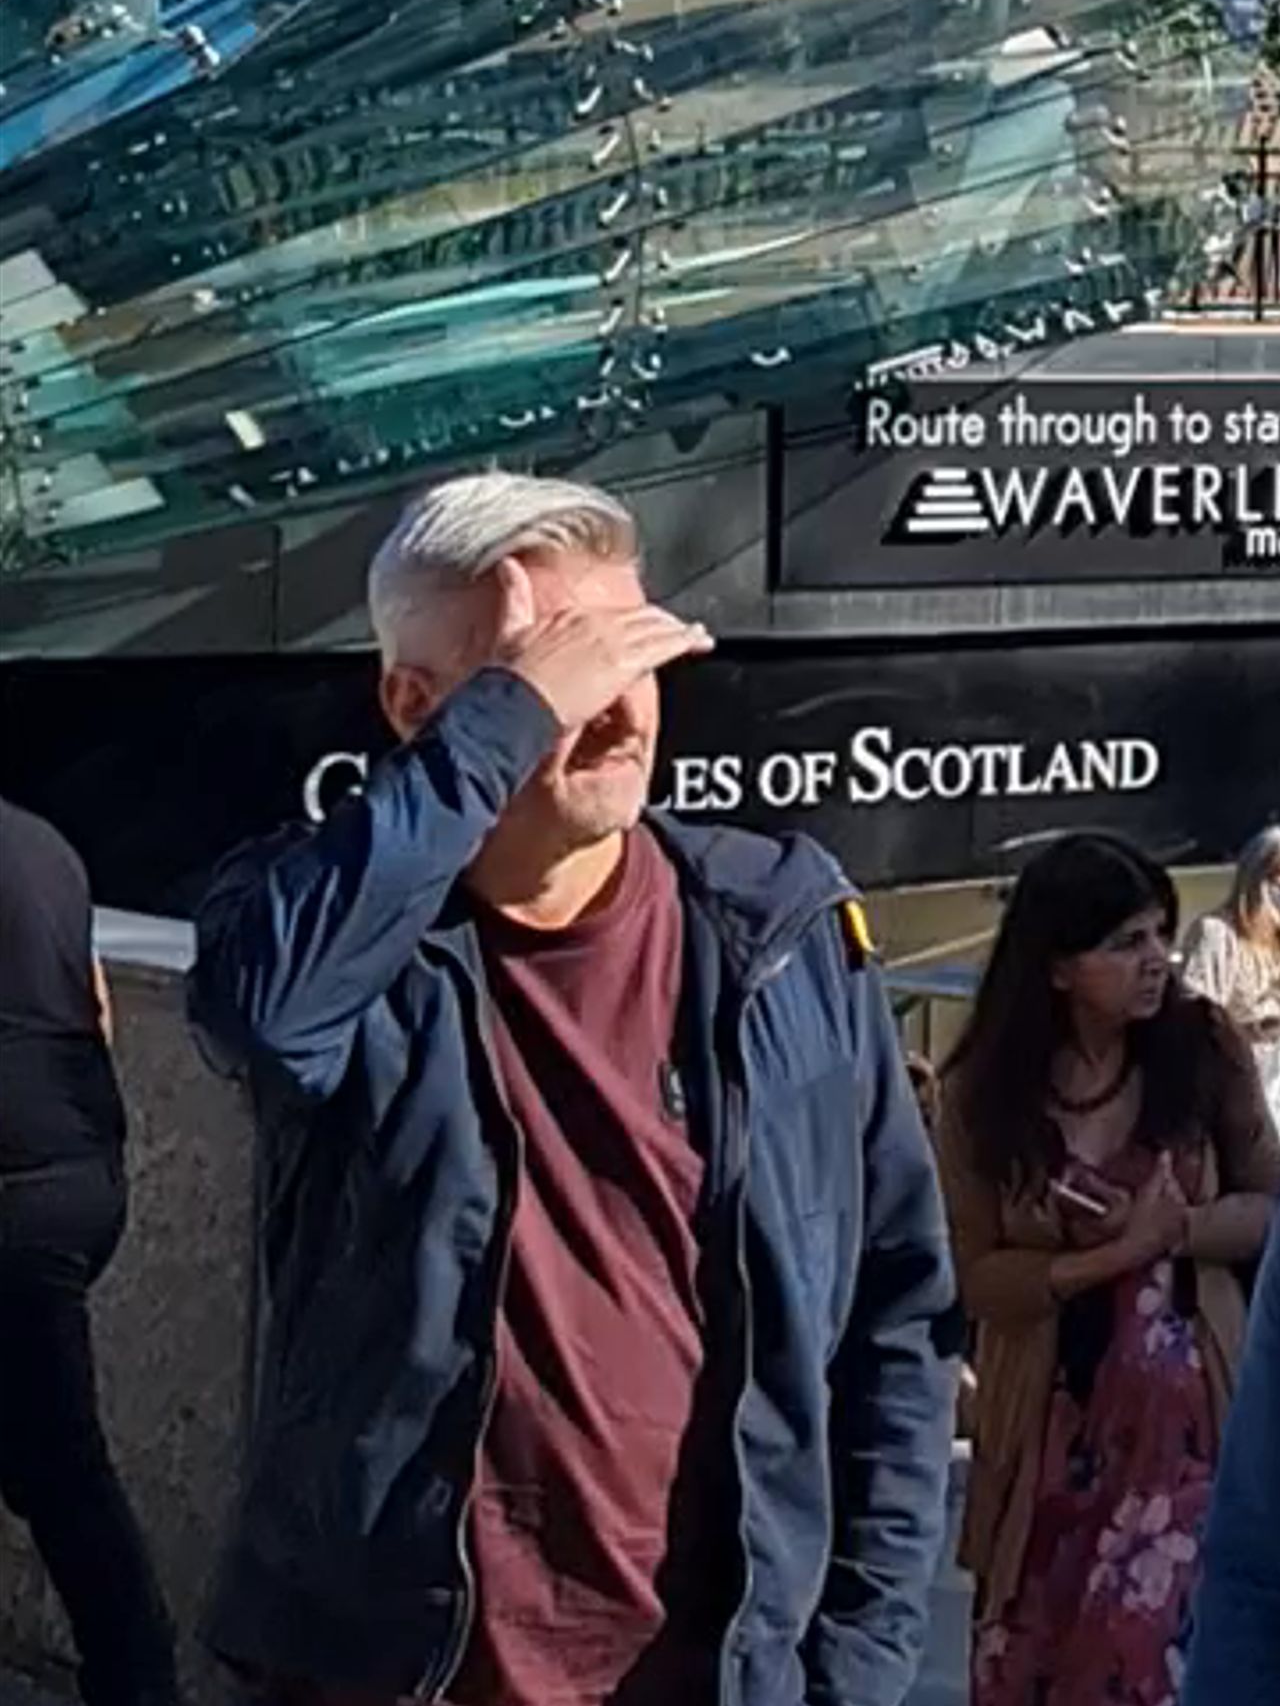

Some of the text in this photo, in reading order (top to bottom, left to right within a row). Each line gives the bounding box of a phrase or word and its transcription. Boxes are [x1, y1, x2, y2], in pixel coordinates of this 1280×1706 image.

[867, 399, 986, 447] Route
[998, 393, 1157, 458] through
[1168, 403, 1212, 444] to
[758, 751, 837, 807] OF
[848, 726, 1159, 803] SCOTLAND
